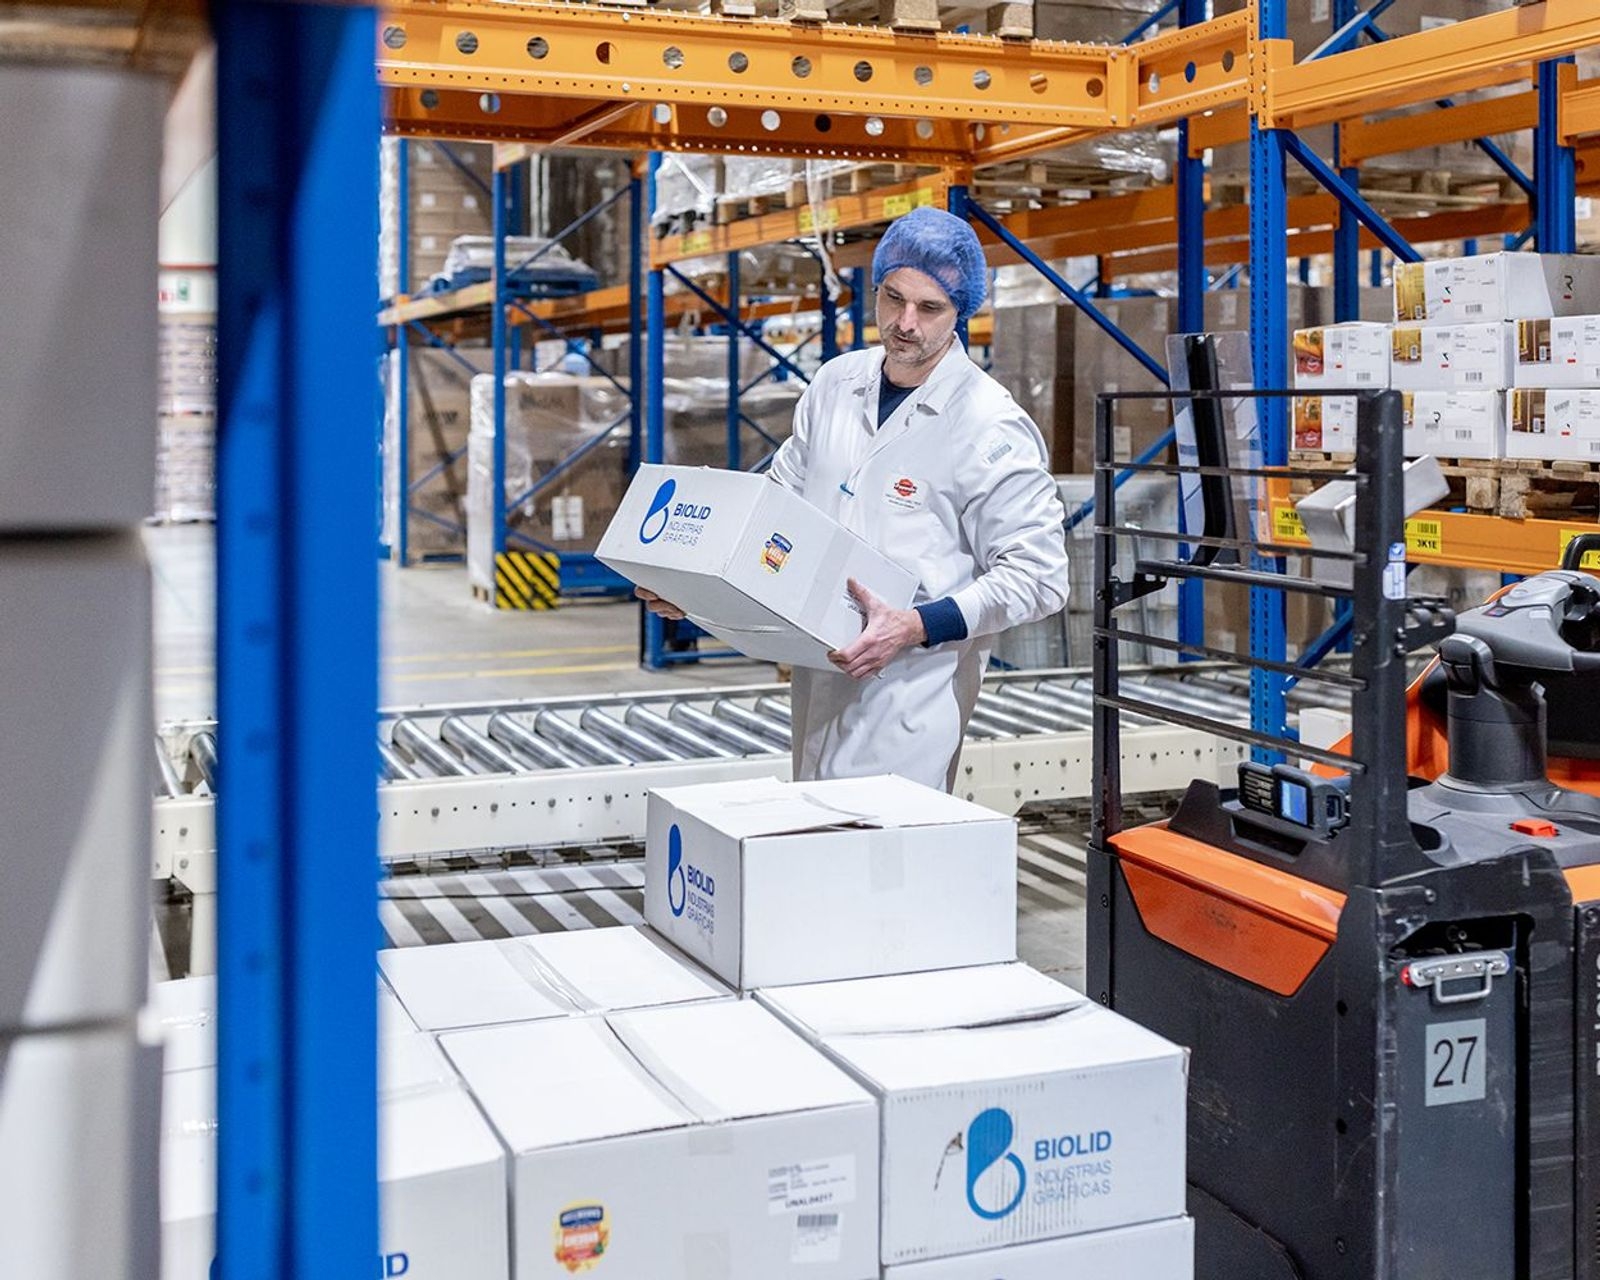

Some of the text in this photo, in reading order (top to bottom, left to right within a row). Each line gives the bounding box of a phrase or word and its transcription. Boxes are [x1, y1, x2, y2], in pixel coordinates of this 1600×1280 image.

[673, 503, 711, 520] BIOLID
[669, 521, 704, 535] INDUSTRIAS
[1417, 538, 1438, 549] 3K1E
[687, 864, 715, 897] BIOLID
[1433, 1035, 1478, 1088] 27
[1034, 1130, 1112, 1162] BIOLID
[1034, 1159, 1112, 1185] INDUSTRIAS
